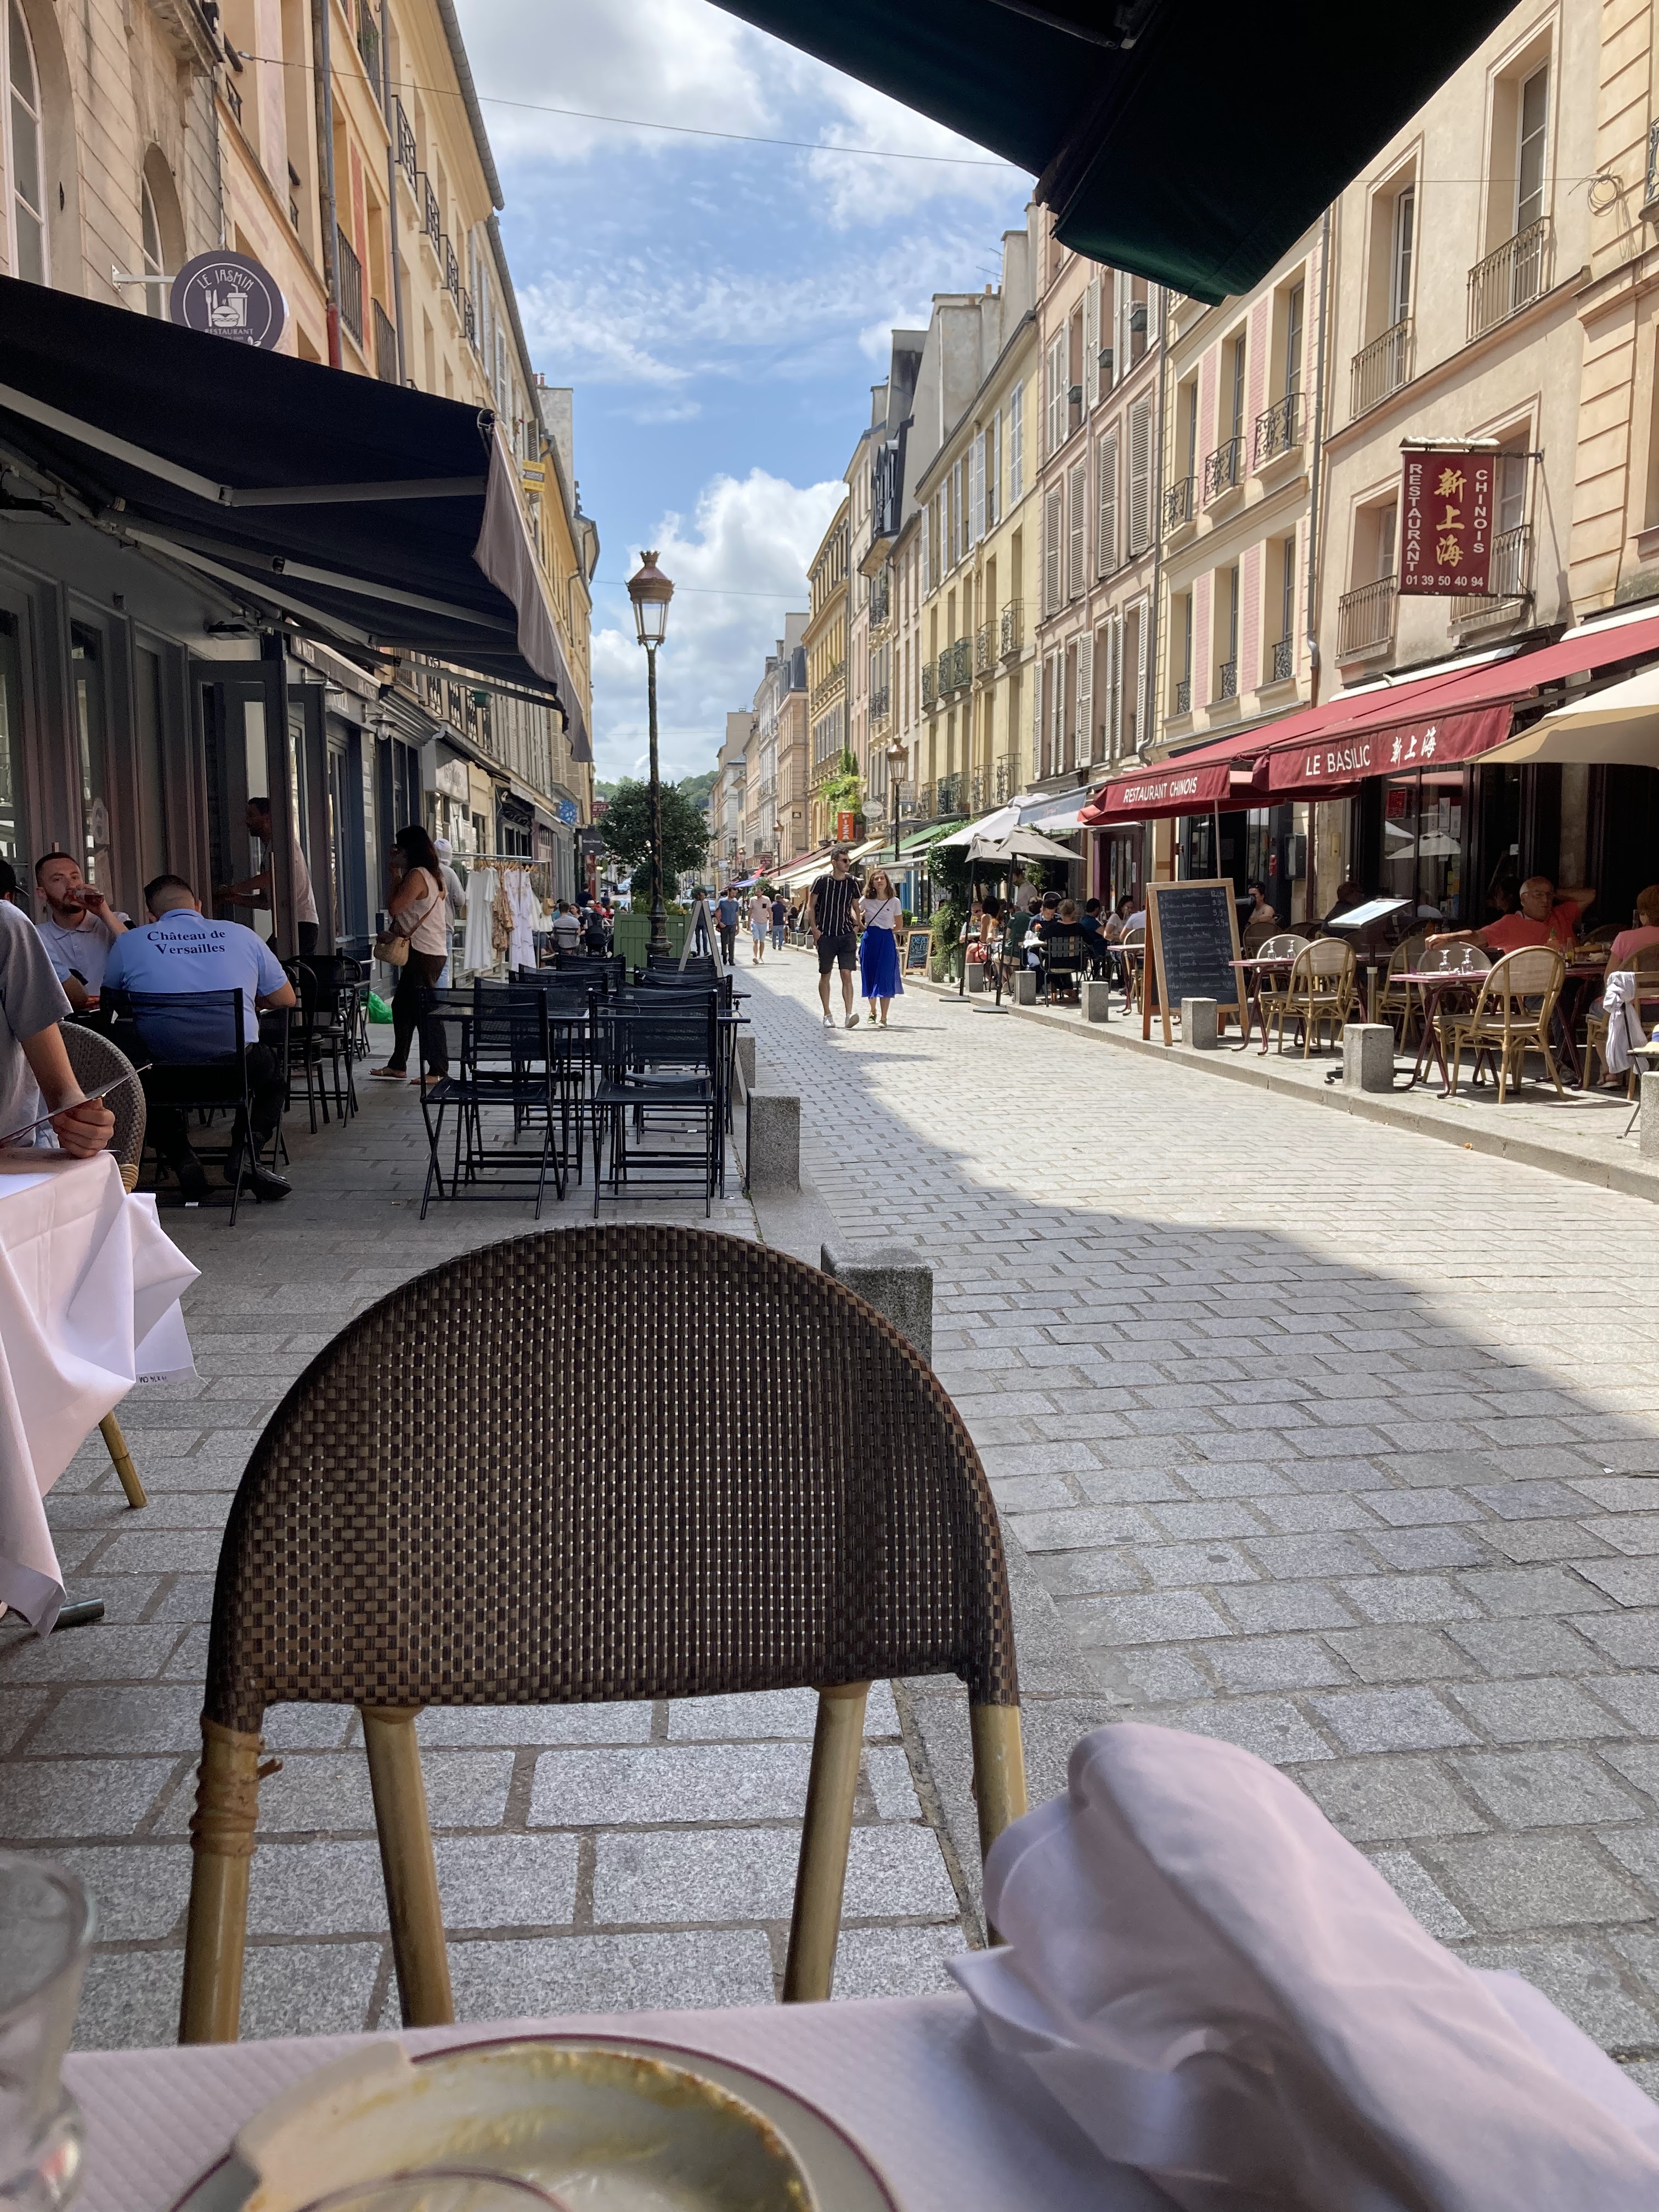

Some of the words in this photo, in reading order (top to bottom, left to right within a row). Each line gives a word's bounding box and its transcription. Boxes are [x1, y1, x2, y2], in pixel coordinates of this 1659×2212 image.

[197, 274, 212, 289] LE
[215, 269, 255, 291] JASMIN
[1406, 463, 1423, 572] RESTAURANT
[1433, 467, 1468, 567] 新上海
[1472, 469, 1488, 554] CHINOIS
[1406, 574, 1418, 585] 01
[1421, 575, 1434, 585] 39
[1438, 575, 1451, 586] 50
[1454, 575, 1468, 586] 40
[1471, 575, 1484, 586] 94
[1305, 755, 1321, 776] LE
[1327, 744, 1371, 774] BASILIC
[1123, 781, 1169, 803] RESTAURANT
[1169, 776, 1199, 798] CHINOIS
[147, 931, 206, 941] Château
[211, 930, 227, 939] de
[154, 943, 225, 955] Versailles
